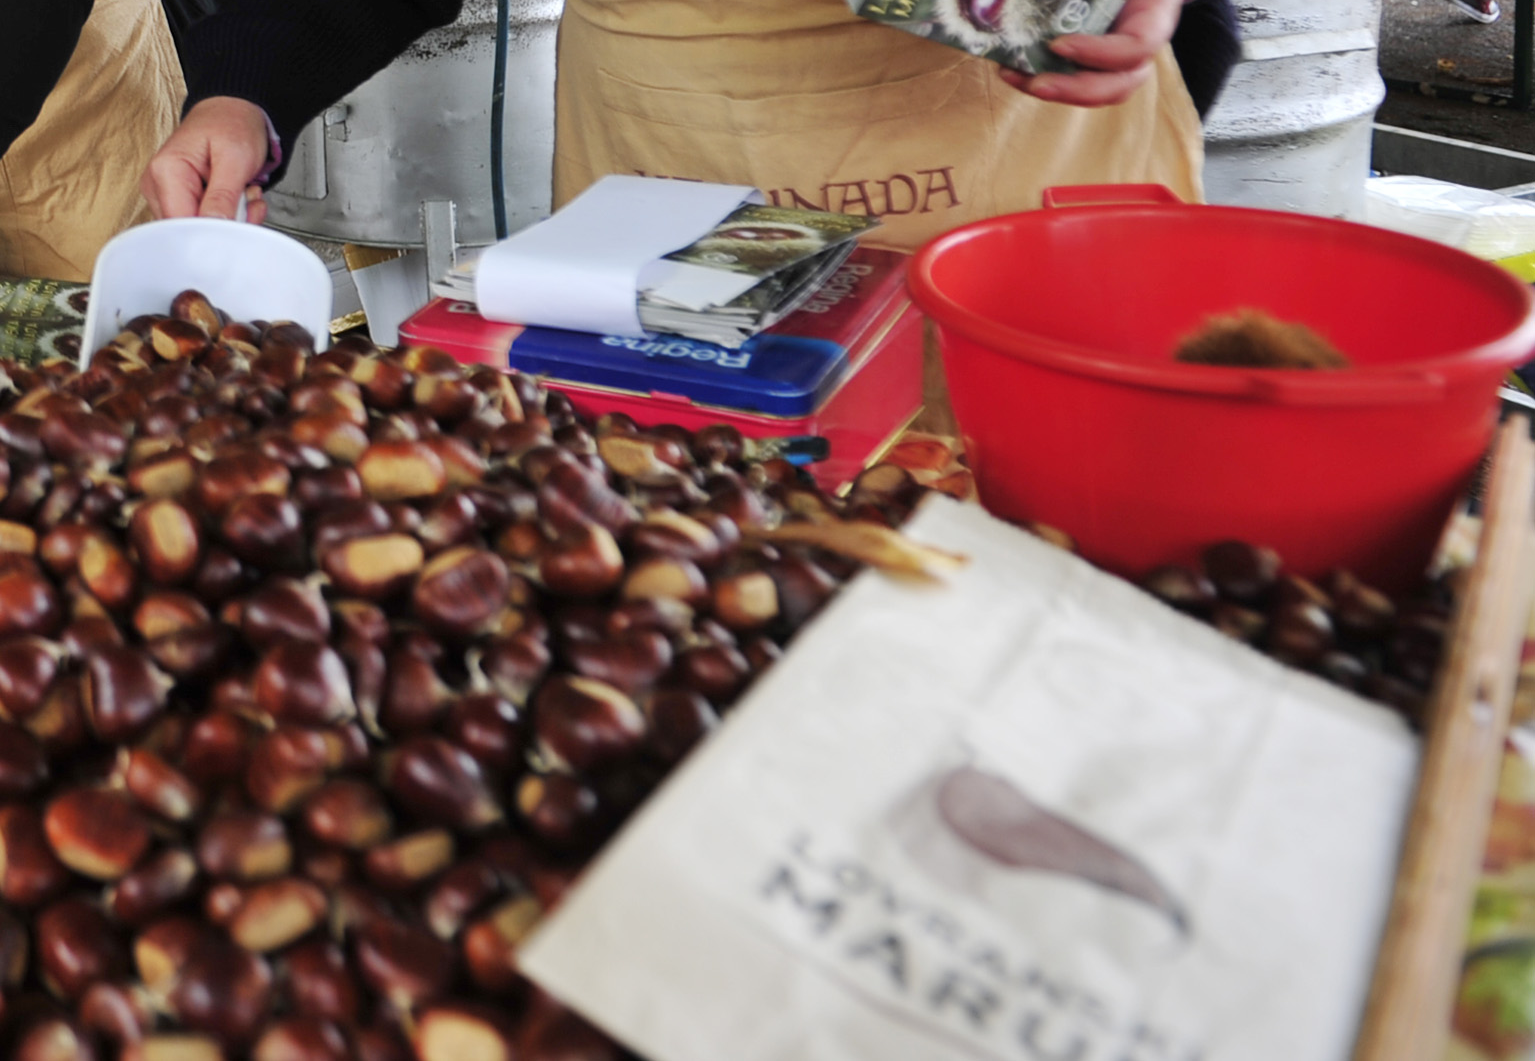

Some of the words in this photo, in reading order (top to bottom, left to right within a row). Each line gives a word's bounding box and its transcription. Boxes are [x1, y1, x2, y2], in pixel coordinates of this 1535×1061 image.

[800, 262, 874, 315] Regina
[600, 335, 752, 370] Regina
[760, 863, 1134, 1061] MARU
